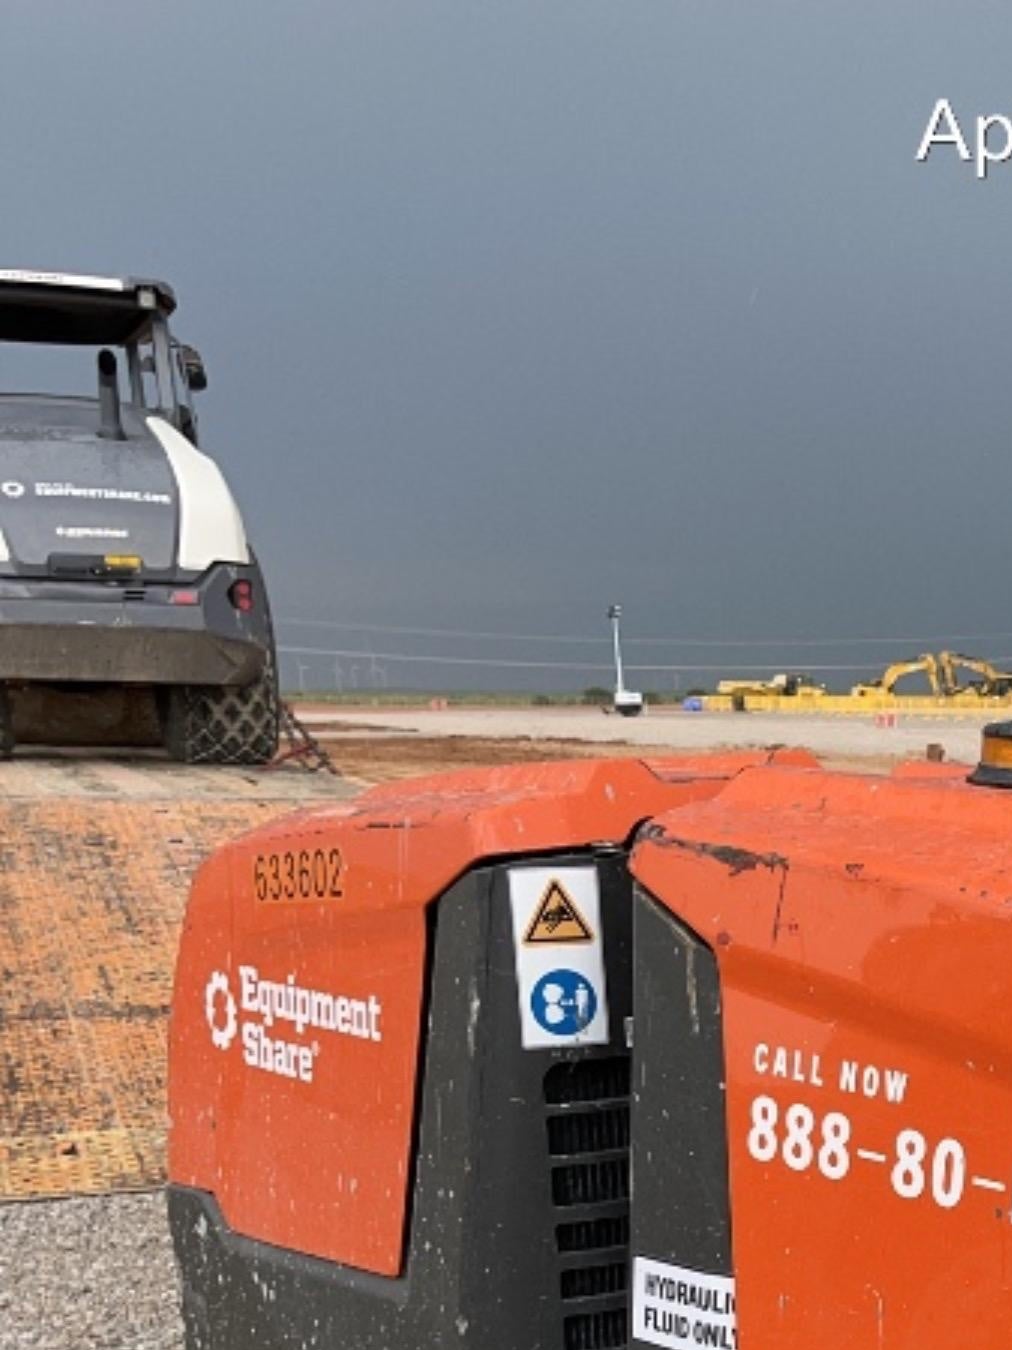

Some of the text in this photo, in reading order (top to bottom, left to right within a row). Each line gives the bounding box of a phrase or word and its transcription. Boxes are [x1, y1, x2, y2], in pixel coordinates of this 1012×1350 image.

[254, 849, 342, 900] 633602
[239, 964, 382, 1042] Equipment
[754, 1043, 907, 1103] CALL NOW
[644, 1306, 690, 1339] FLUID
